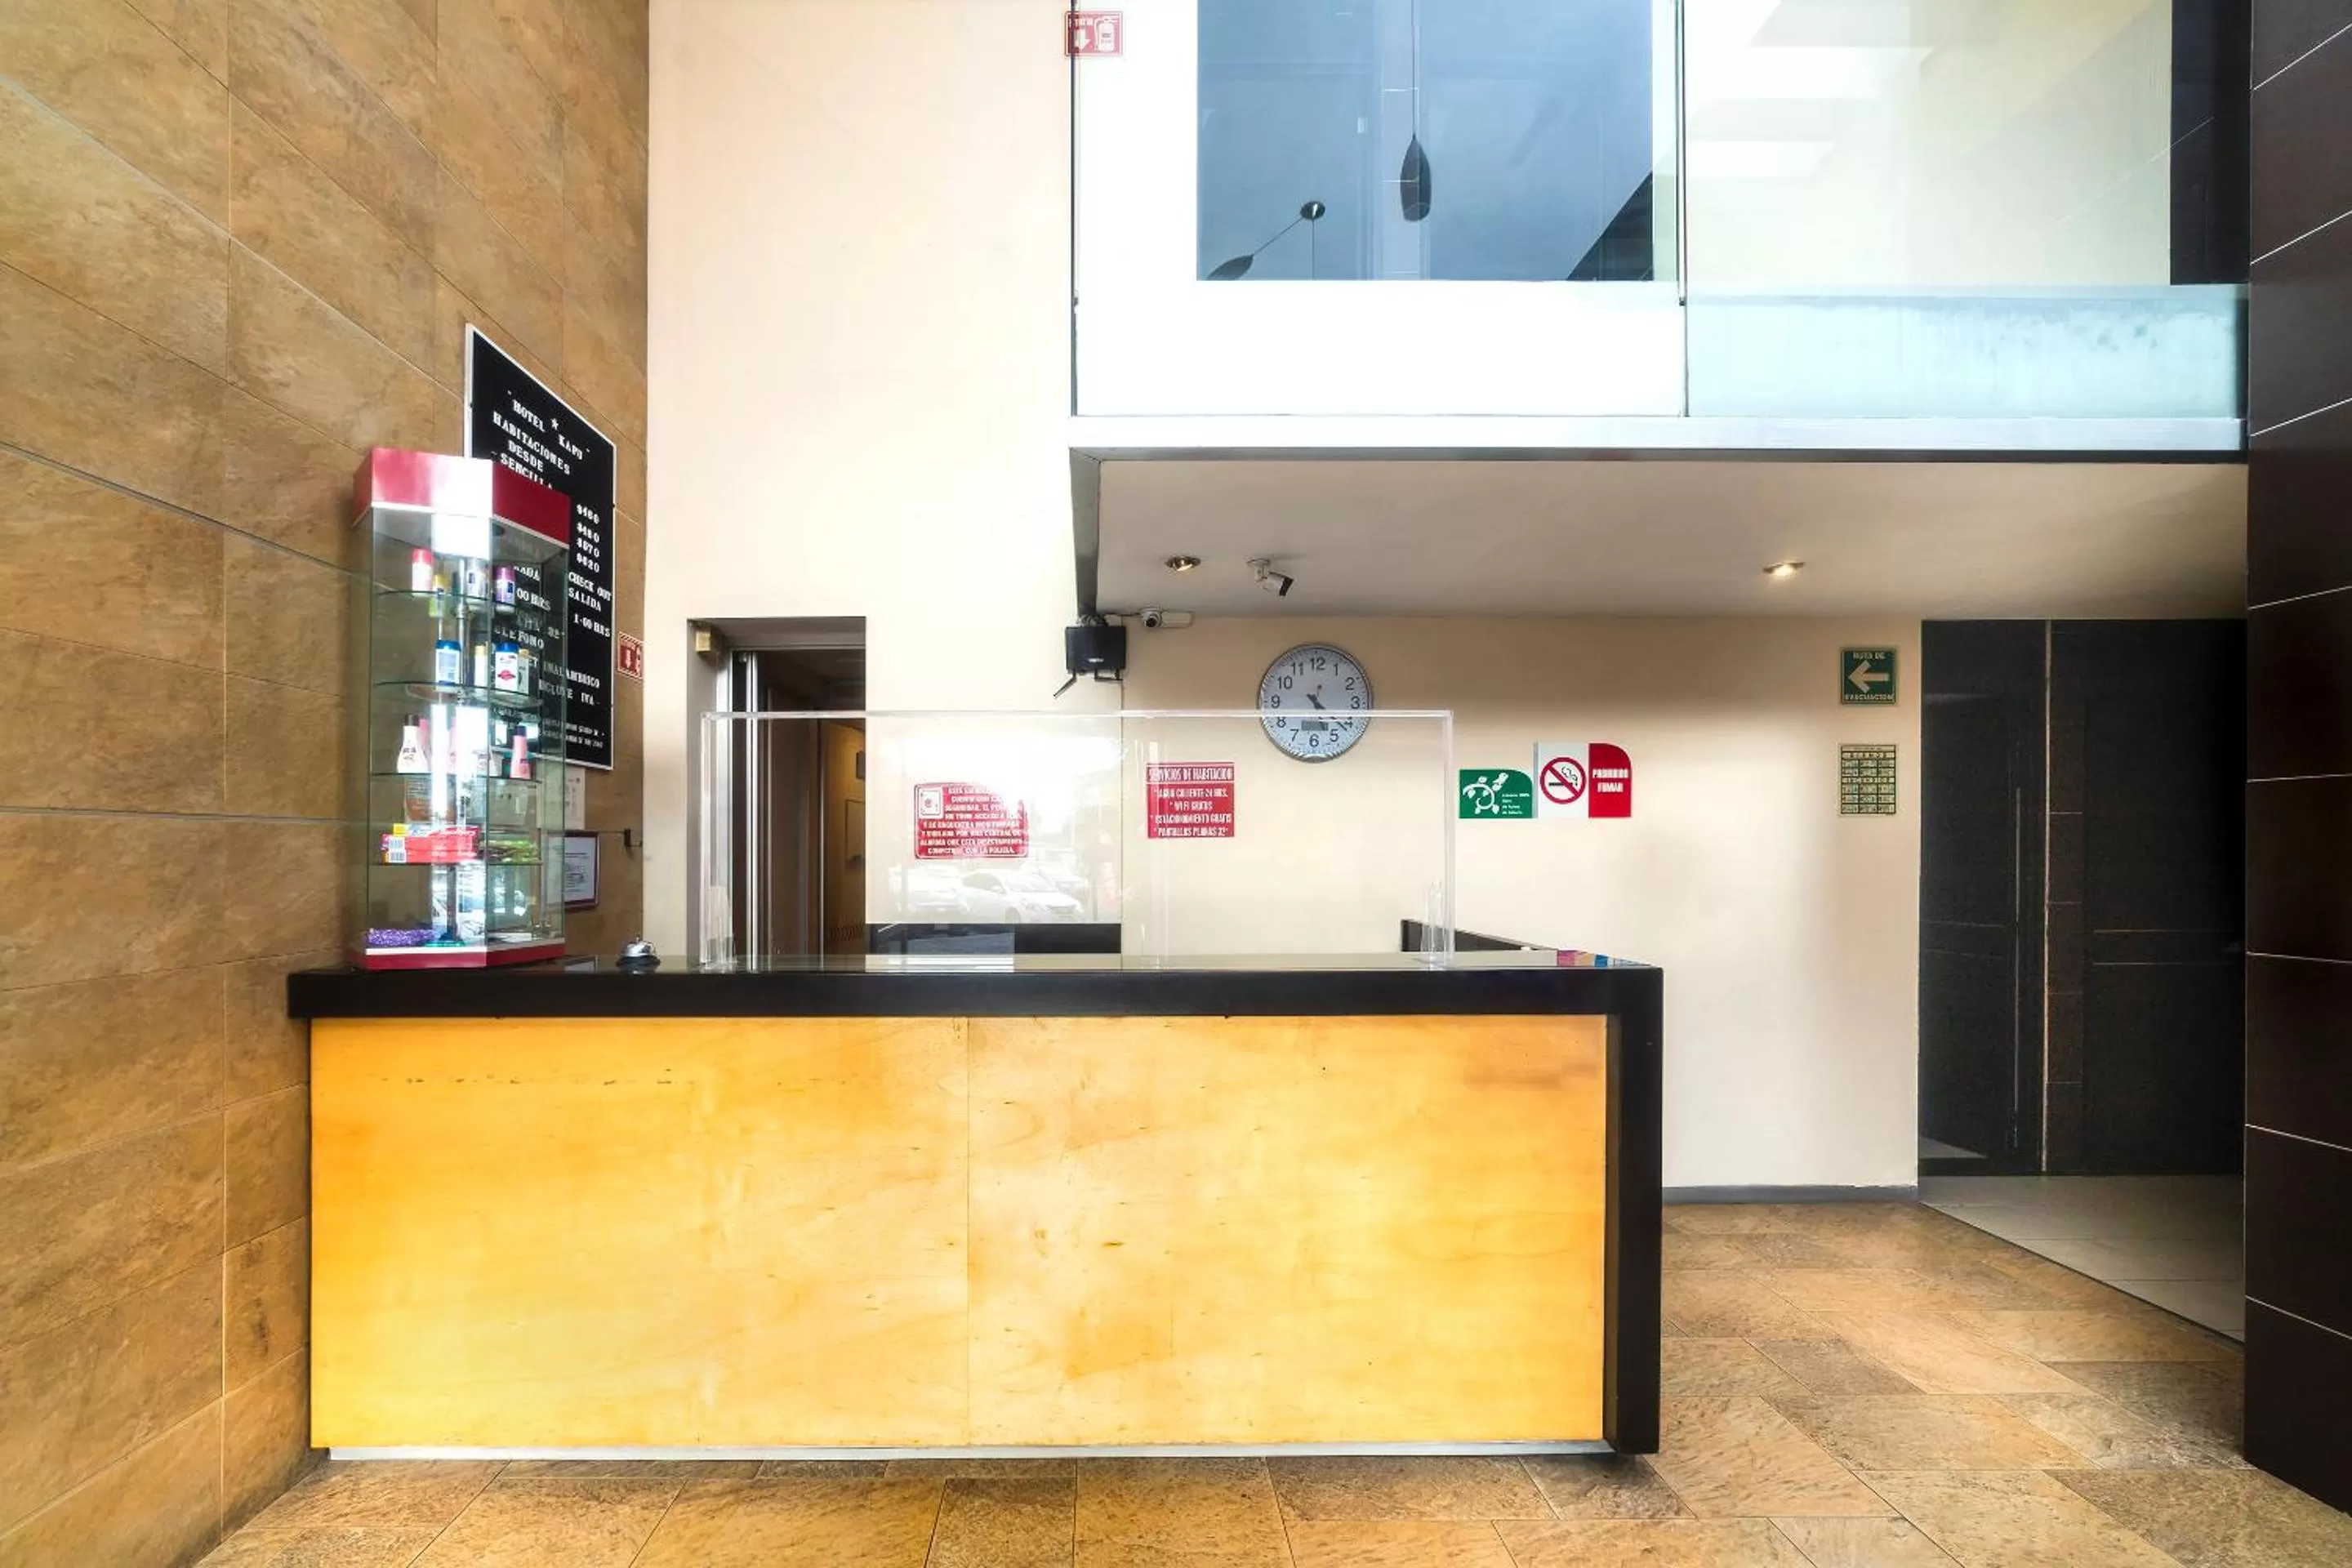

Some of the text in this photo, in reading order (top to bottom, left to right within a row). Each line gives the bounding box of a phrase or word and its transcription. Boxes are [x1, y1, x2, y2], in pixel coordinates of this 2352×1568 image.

[512, 399, 546, 433] HOTEL
[492, 411, 570, 475] HABITACIONES
[508, 439, 544, 473] DESDE
[568, 572, 595, 593] CHECK
[568, 587, 602, 612] SALIDA
[1291, 662, 1304, 676] 11
[1309, 656, 1326, 670] 12
[1276, 675, 1293, 690] 10
[1344, 676, 1356, 691] 2
[1271, 694, 1281, 709] 9
[1350, 695, 1361, 710] 3
[1290, 728, 1300, 742] 7
[1308, 733, 1320, 748] 6
[1329, 728, 1339, 742] 5
[1597, 782, 1624, 792] FUMAR
